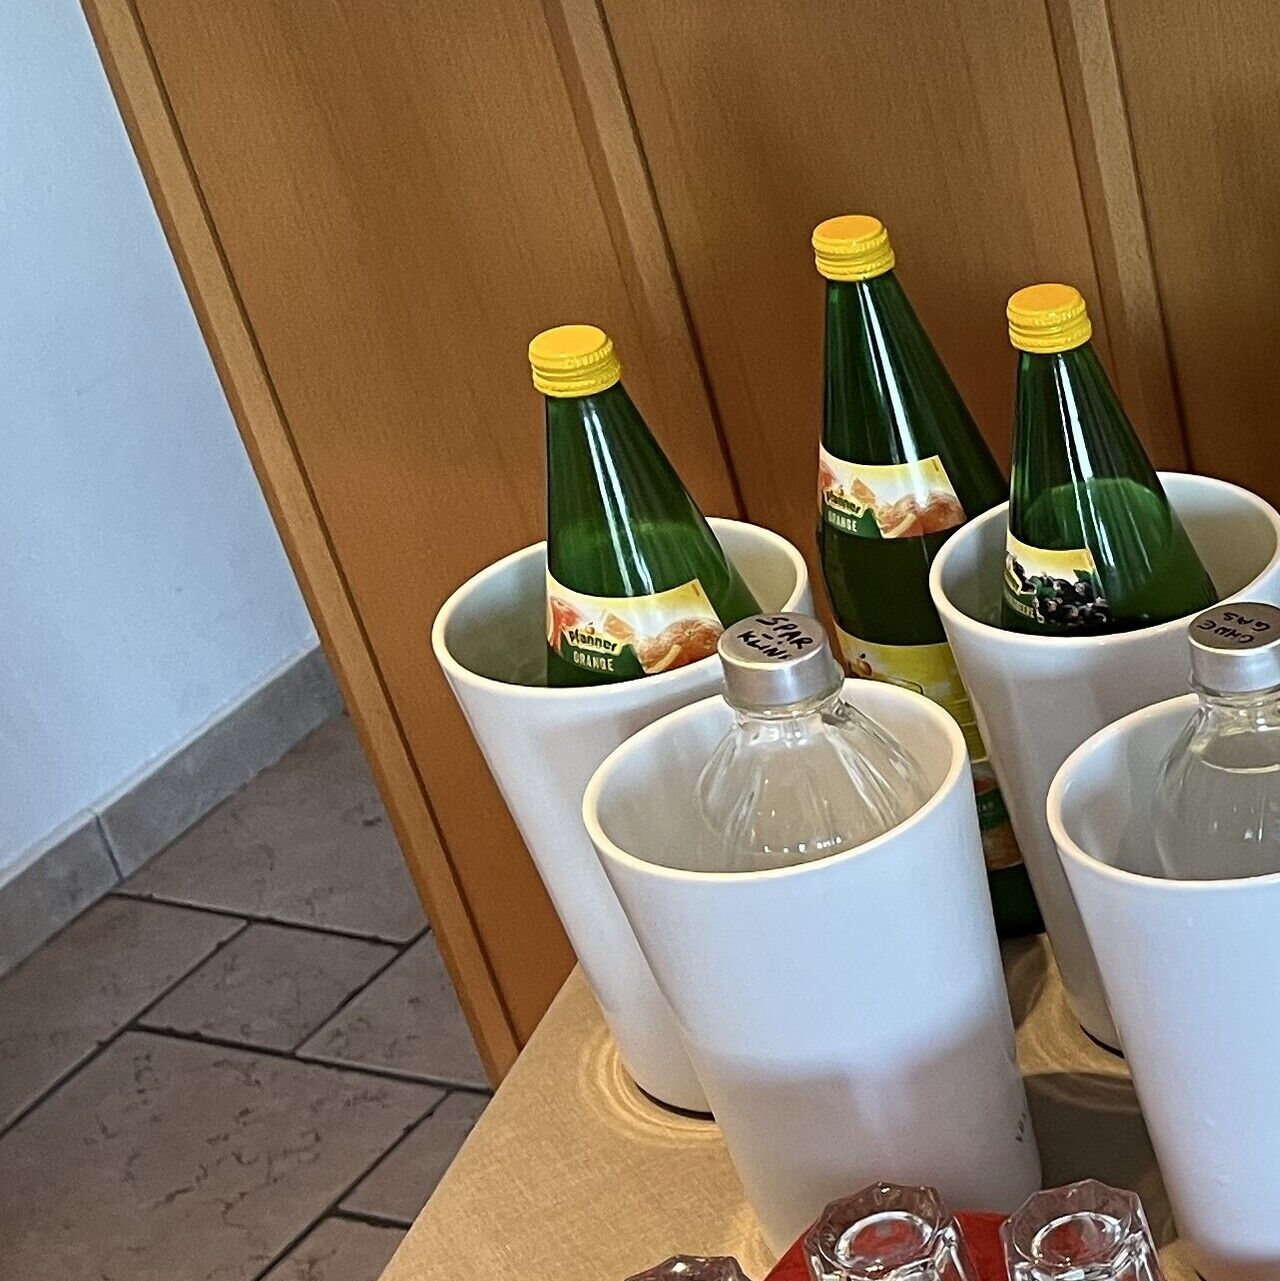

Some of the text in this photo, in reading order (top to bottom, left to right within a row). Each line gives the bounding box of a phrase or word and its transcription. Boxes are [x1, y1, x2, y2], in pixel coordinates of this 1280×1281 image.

[755, 617, 813, 649] SPAR
[1223, 612, 1271, 631] GAS
[568, 629, 618, 653] Pfanner
[573, 650, 615, 672] ORANGE
